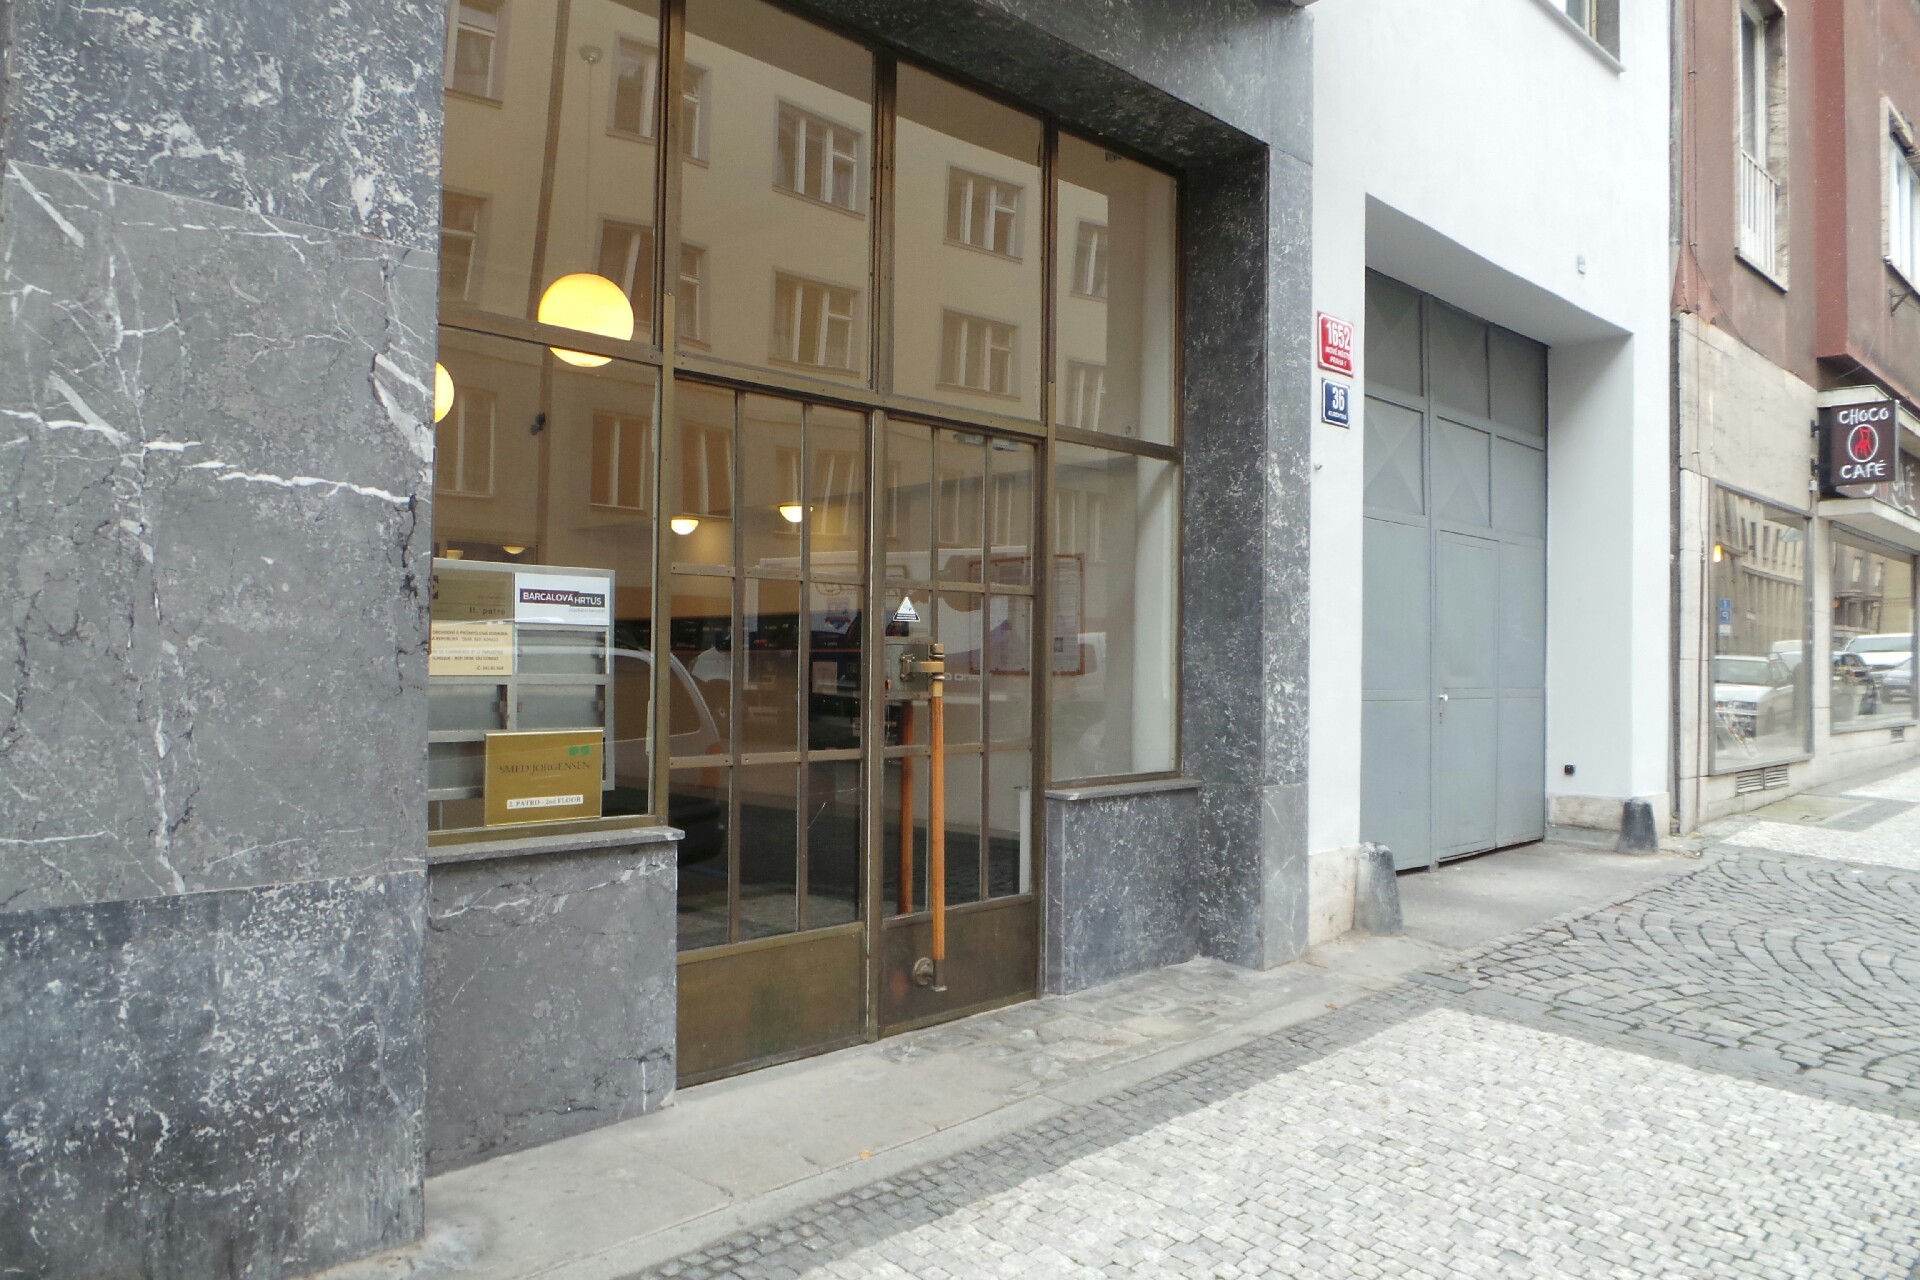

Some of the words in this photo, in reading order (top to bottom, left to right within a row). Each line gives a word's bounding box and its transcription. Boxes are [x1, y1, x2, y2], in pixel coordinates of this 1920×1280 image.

[1326, 322, 1351, 350] 1652
[1332, 386, 1345, 410] 36
[1838, 407, 1889, 425] CHOCO
[1841, 460, 1887, 479] CAFÉ
[522, 591, 574, 602] BARCALOVÁ
[574, 596, 602, 606] HRTUS
[482, 608, 506, 616] patro
[515, 799, 541, 807] PATRO
[545, 797, 556, 805] 2nd
[557, 796, 581, 804] FLOOR
